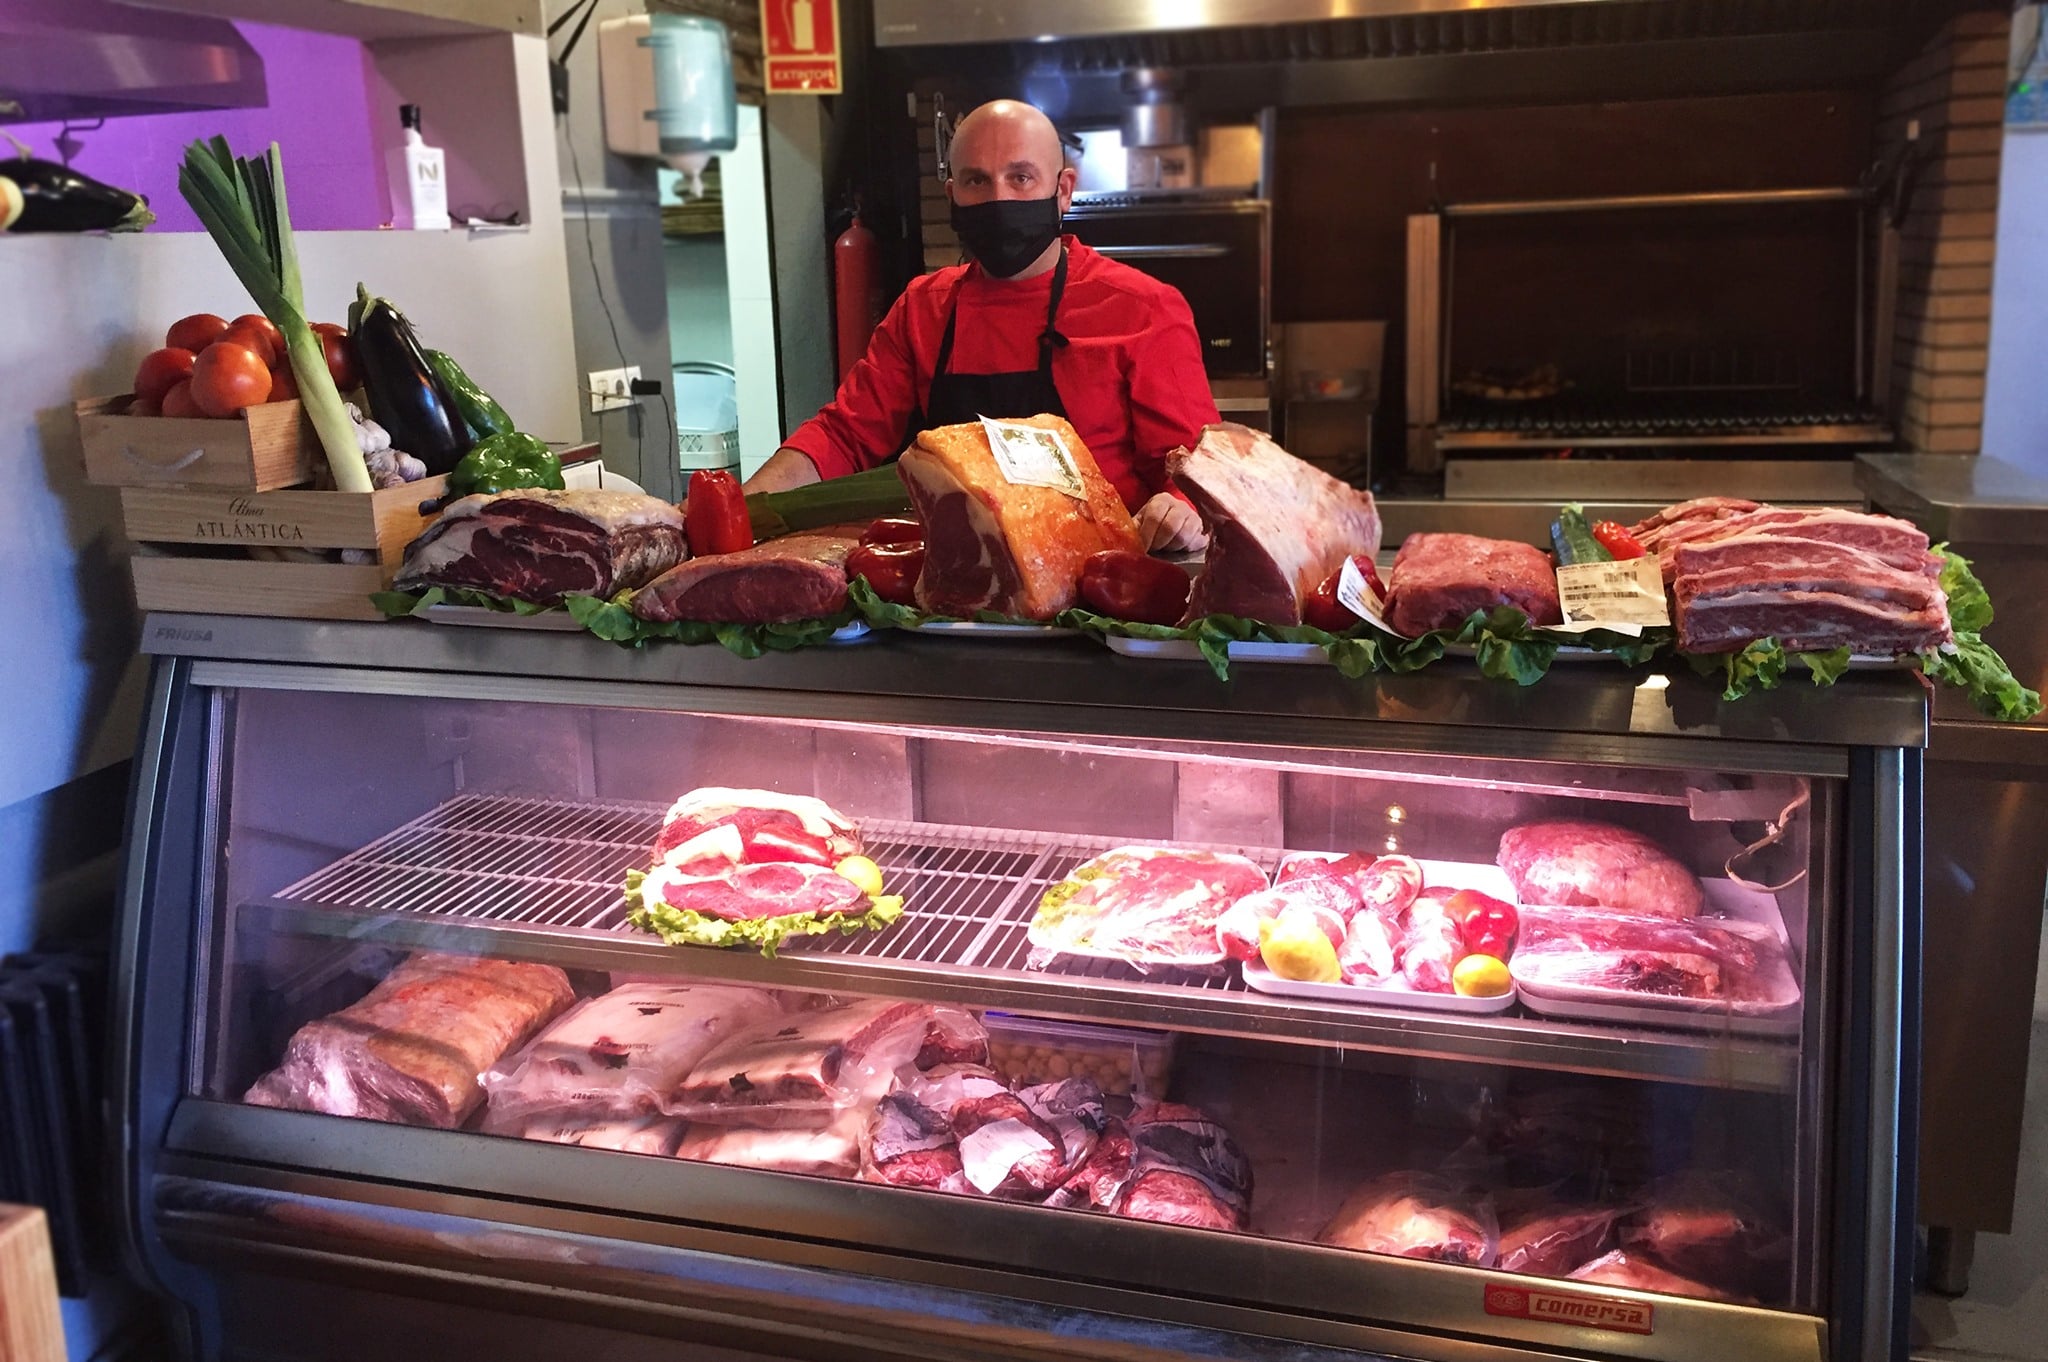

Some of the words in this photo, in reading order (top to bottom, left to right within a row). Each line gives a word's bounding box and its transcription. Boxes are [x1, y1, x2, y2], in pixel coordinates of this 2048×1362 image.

[774, 69, 830, 81] EXTINTOR
[417, 162, 439, 181] N
[195, 519, 304, 540] ATLÁNTICA
[1535, 1298, 1643, 1324] comersa
